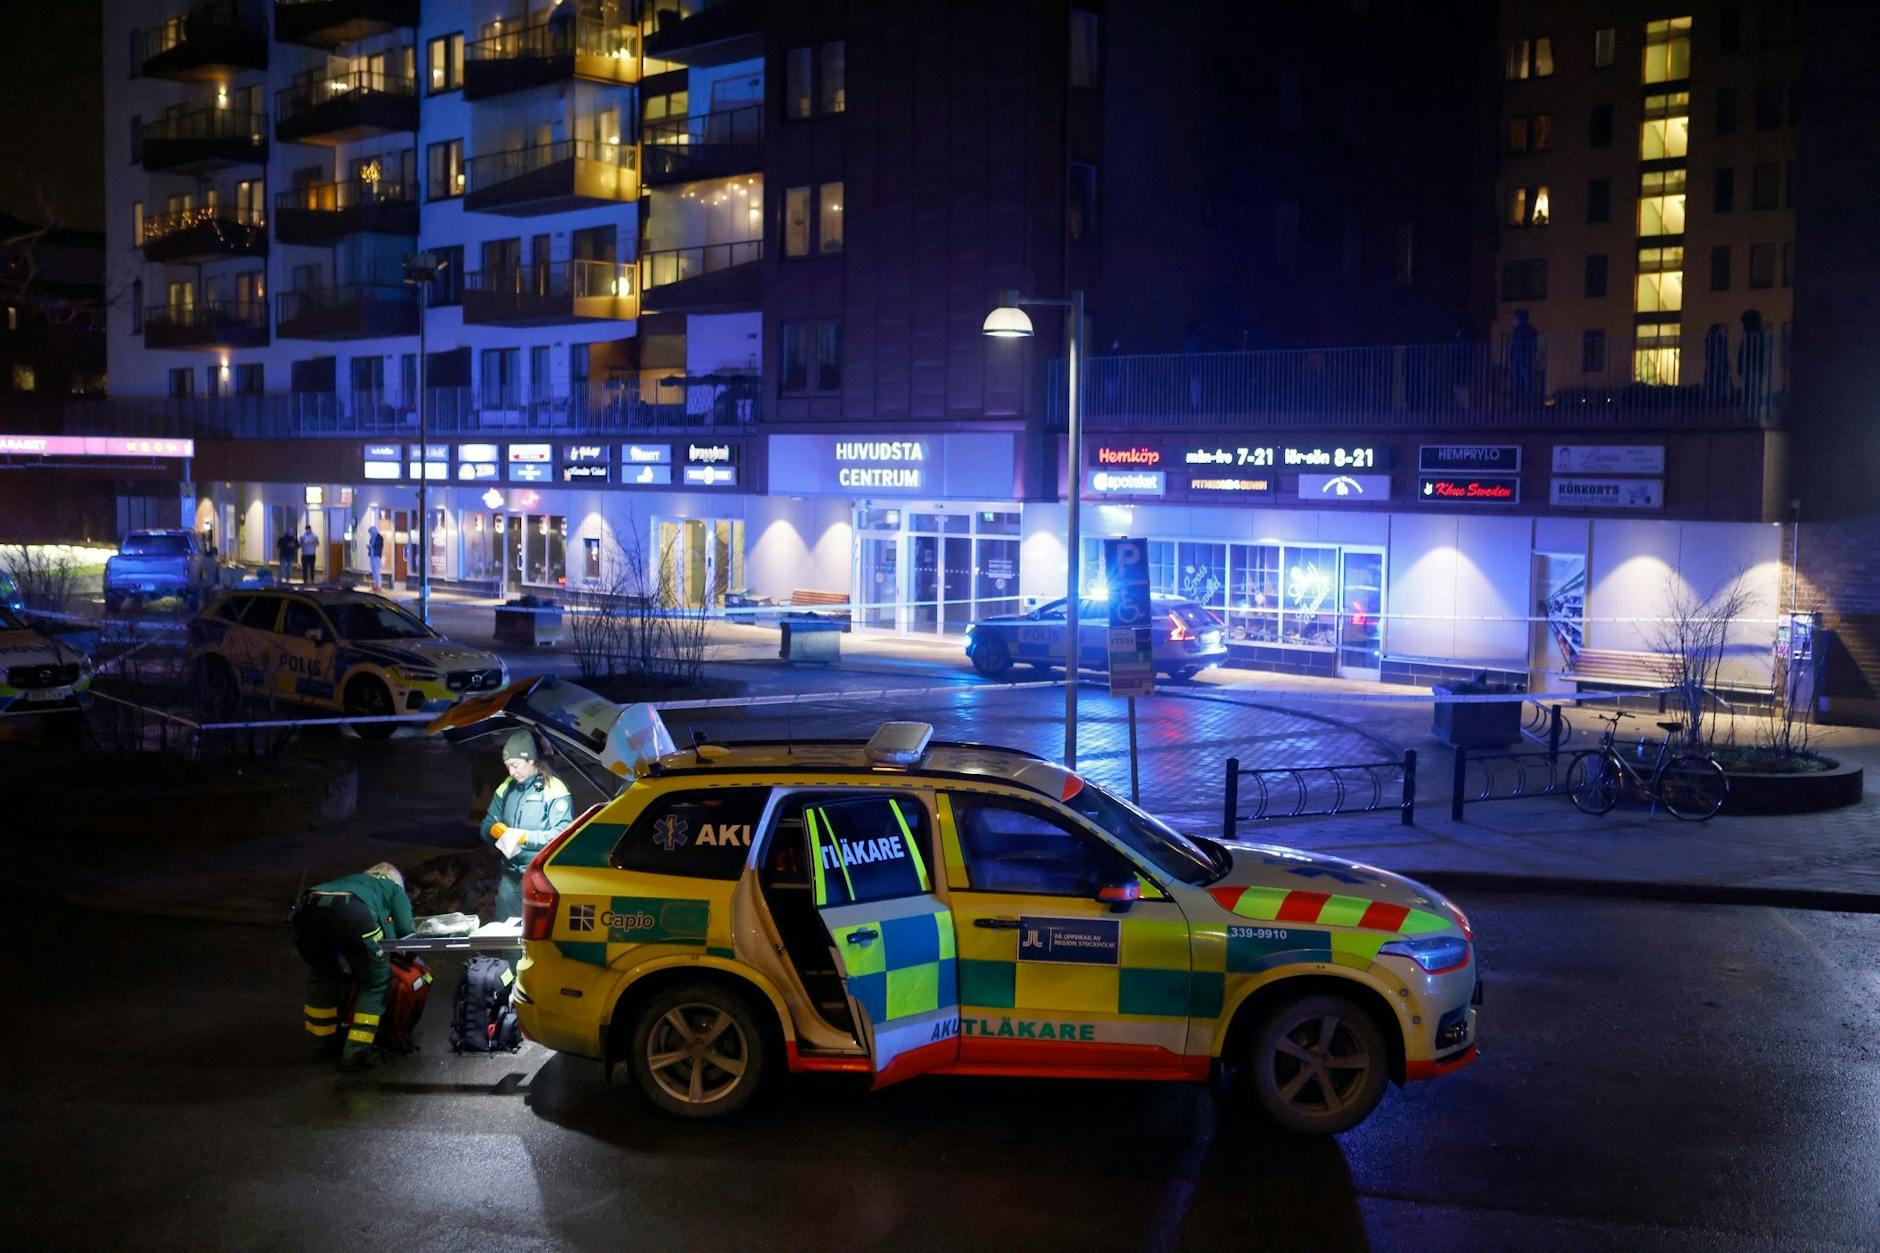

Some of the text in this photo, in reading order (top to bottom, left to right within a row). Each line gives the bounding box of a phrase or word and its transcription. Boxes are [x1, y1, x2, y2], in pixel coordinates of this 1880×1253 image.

[836, 442, 922, 460] HUVUDSTA
[1099, 447, 1160, 465] Hemköp
[1237, 448, 1273, 465] 7-21
[1334, 448, 1373, 467] 8-21
[839, 468, 919, 487] CENTRUM
[1467, 482, 1512, 496] Sweden
[1558, 482, 1620, 496] KÖRKORTS
[1117, 543, 1140, 576] P
[1024, 629, 1060, 642] POLIS
[279, 655, 321, 675] POLIS
[600, 911, 655, 932] Capio
[1231, 926, 1288, 940] 339-9910
[1078, 941, 1115, 949] STOCKHOLM
